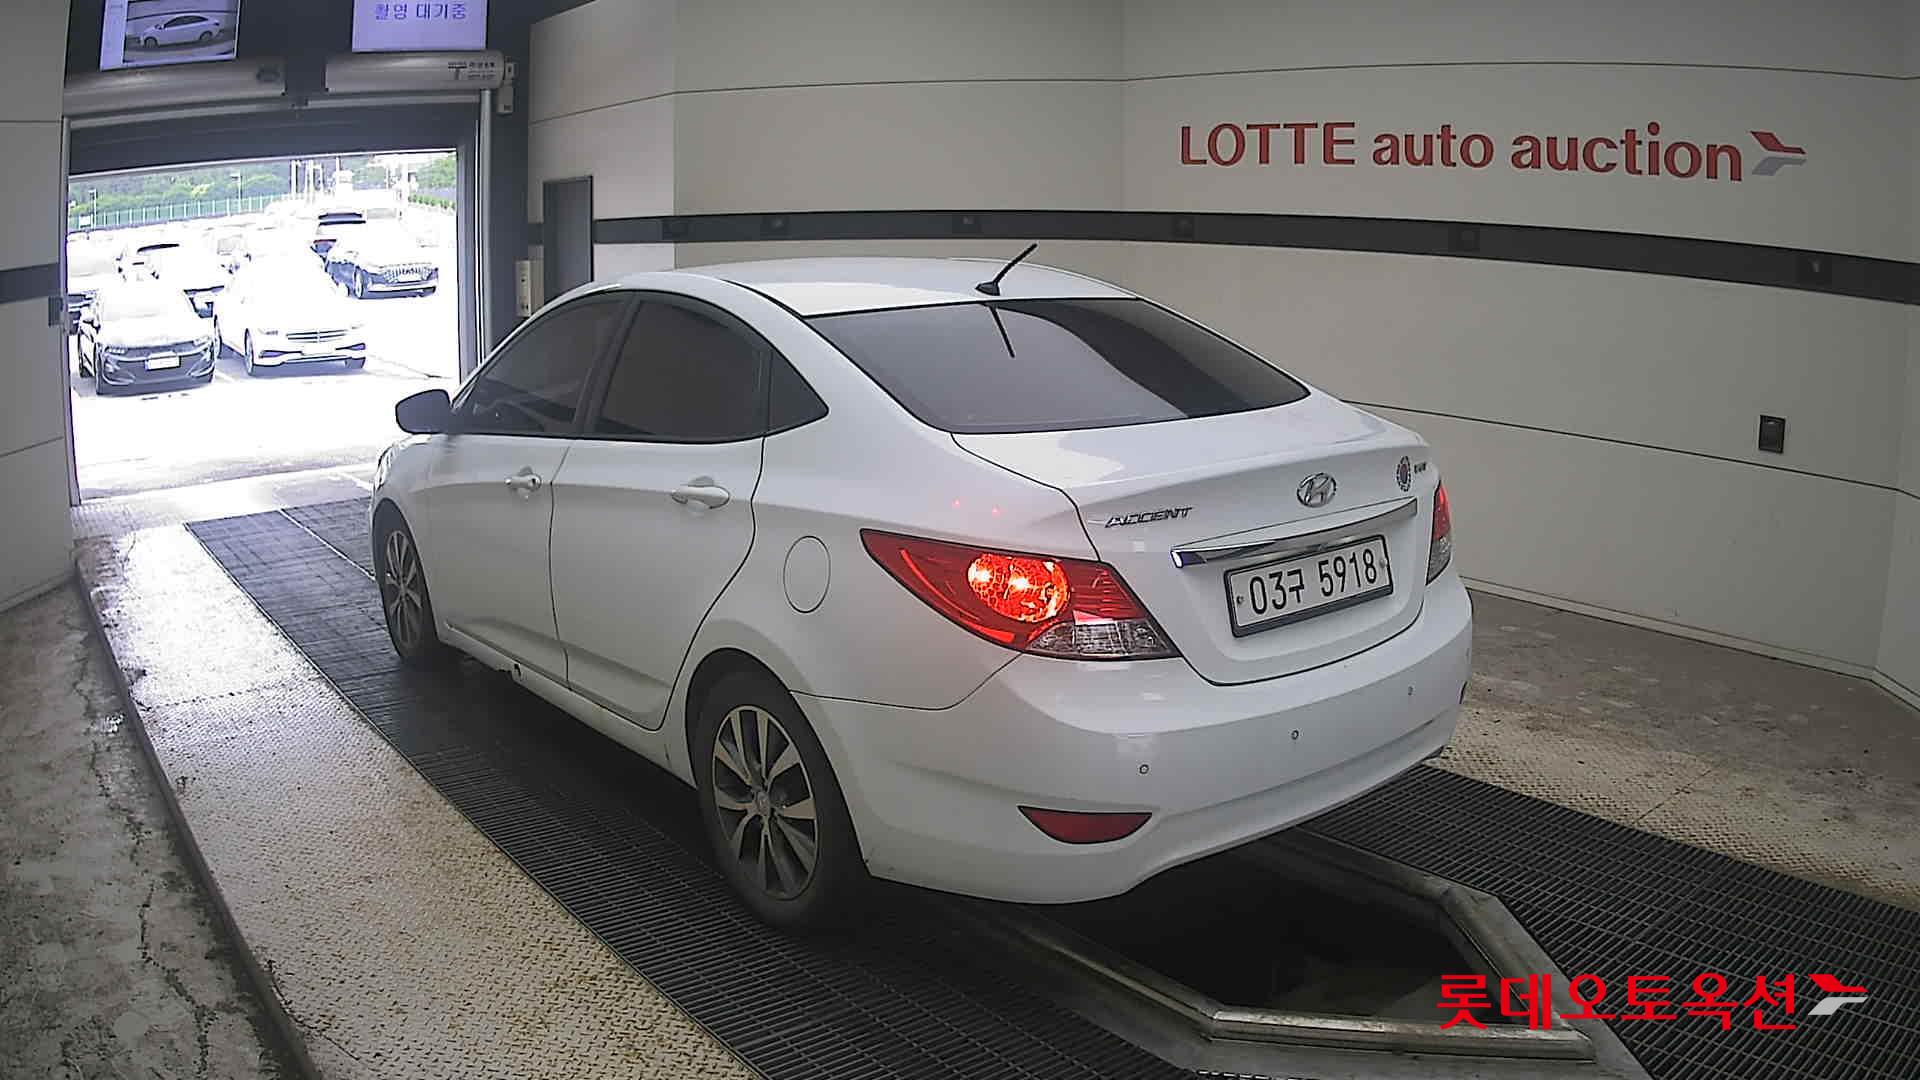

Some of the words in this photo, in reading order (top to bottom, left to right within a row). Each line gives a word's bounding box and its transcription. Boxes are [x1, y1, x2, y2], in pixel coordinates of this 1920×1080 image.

[416, 3, 466, 20] 대기중
[1181, 122, 1356, 166] LOTTE
[1372, 123, 1495, 169] auto
[1511, 121, 1744, 183] auction
[1105, 506, 1193, 529] ACCENT
[1249, 569, 1305, 614] 03구
[1318, 549, 1377, 597] 5918
